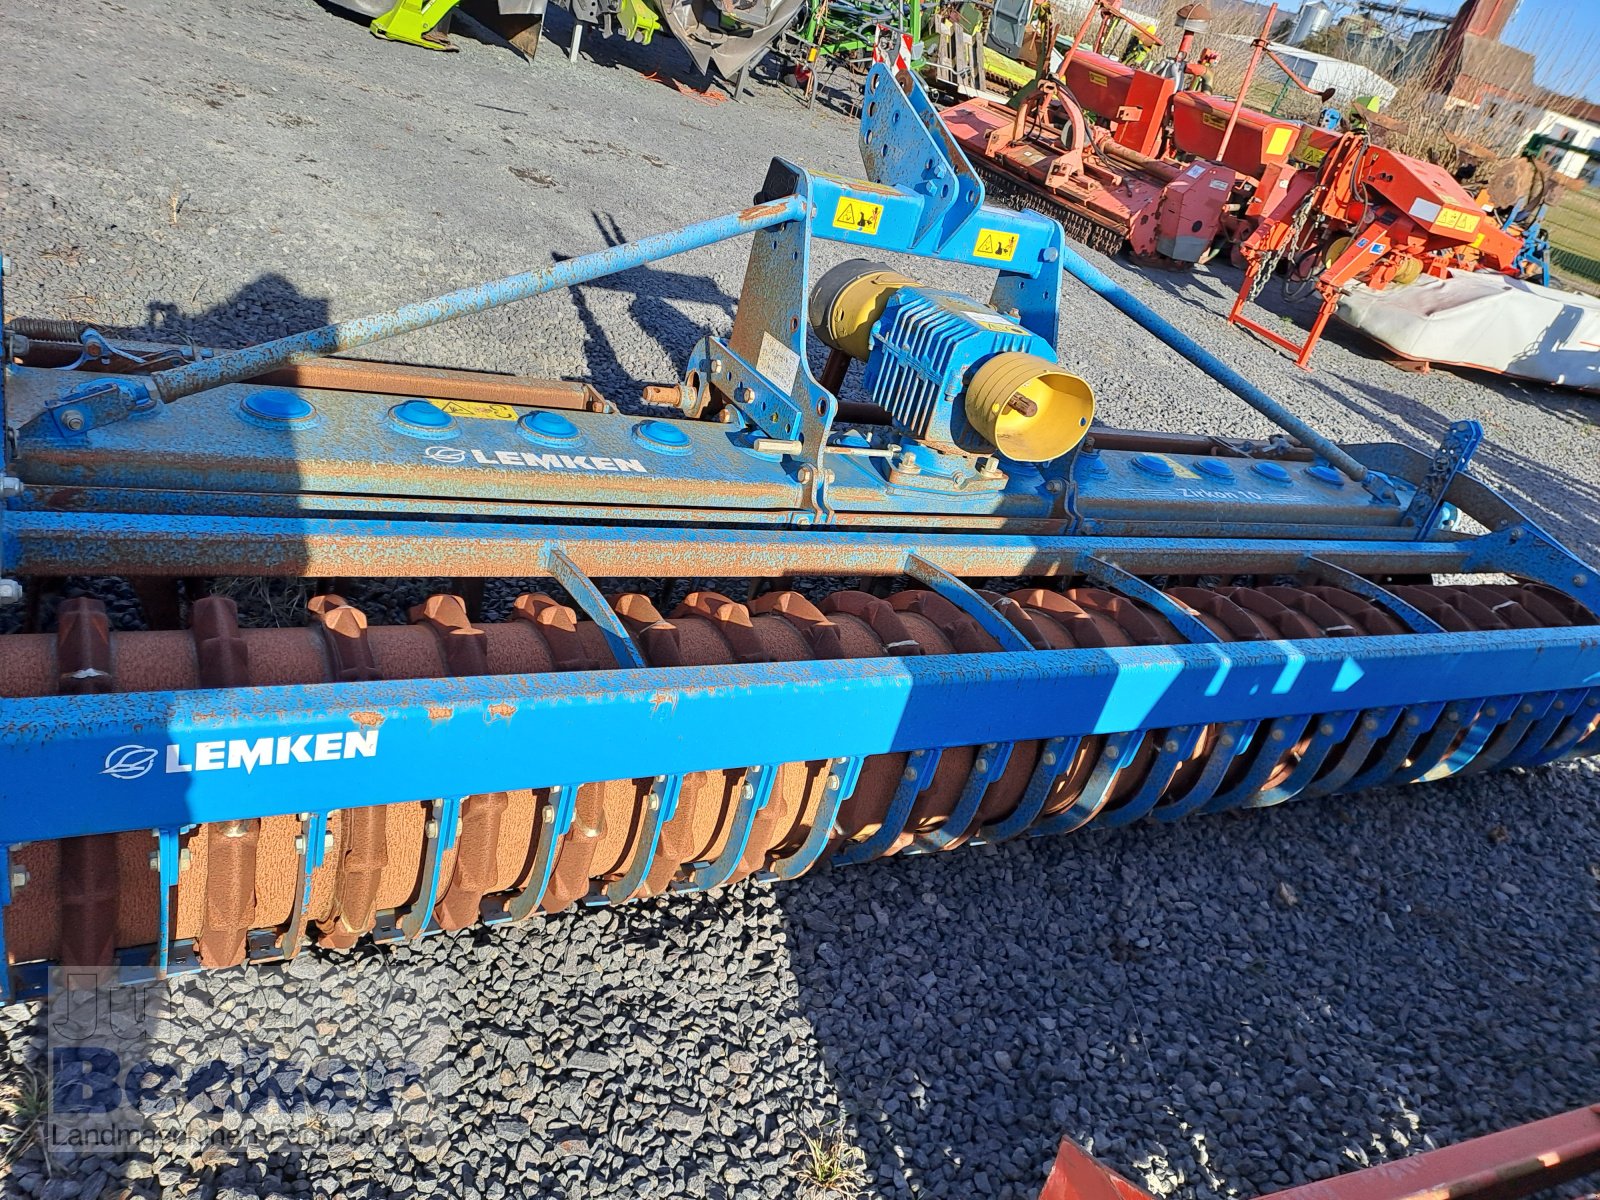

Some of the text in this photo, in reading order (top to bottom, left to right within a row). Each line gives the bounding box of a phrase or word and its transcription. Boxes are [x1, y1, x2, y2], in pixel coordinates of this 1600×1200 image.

[470, 449, 647, 473] LEMKEN
[1176, 488, 1262, 501] Zirkon 10
[165, 730, 379, 775] LEMKEN
